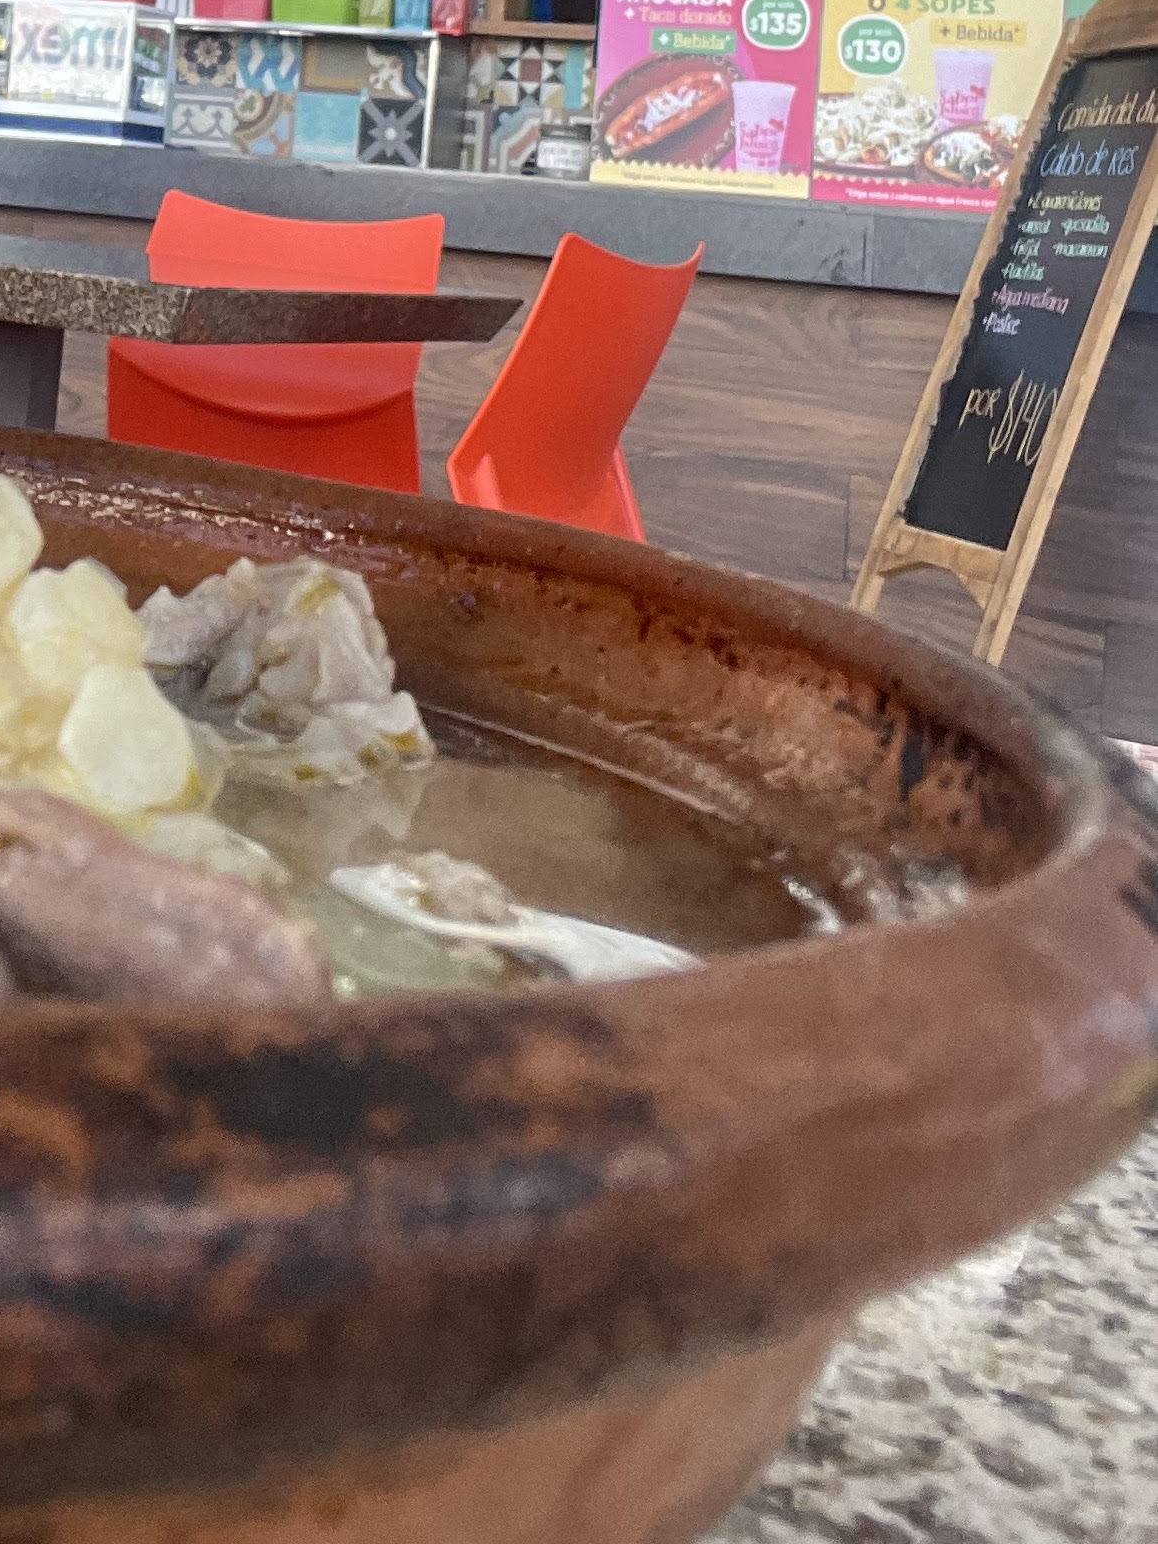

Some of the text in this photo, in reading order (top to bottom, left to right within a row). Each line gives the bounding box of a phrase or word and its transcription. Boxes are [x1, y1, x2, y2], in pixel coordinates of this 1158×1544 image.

[639, 6, 676, 23] Taco
[679, 8, 732, 26] dorado
[749, 11, 802, 35] $135
[844, 39, 902, 64] $130
[1040, 140, 1085, 177] Caldo
[1085, 138, 1109, 177] de
[987, 368, 1058, 467] $140
